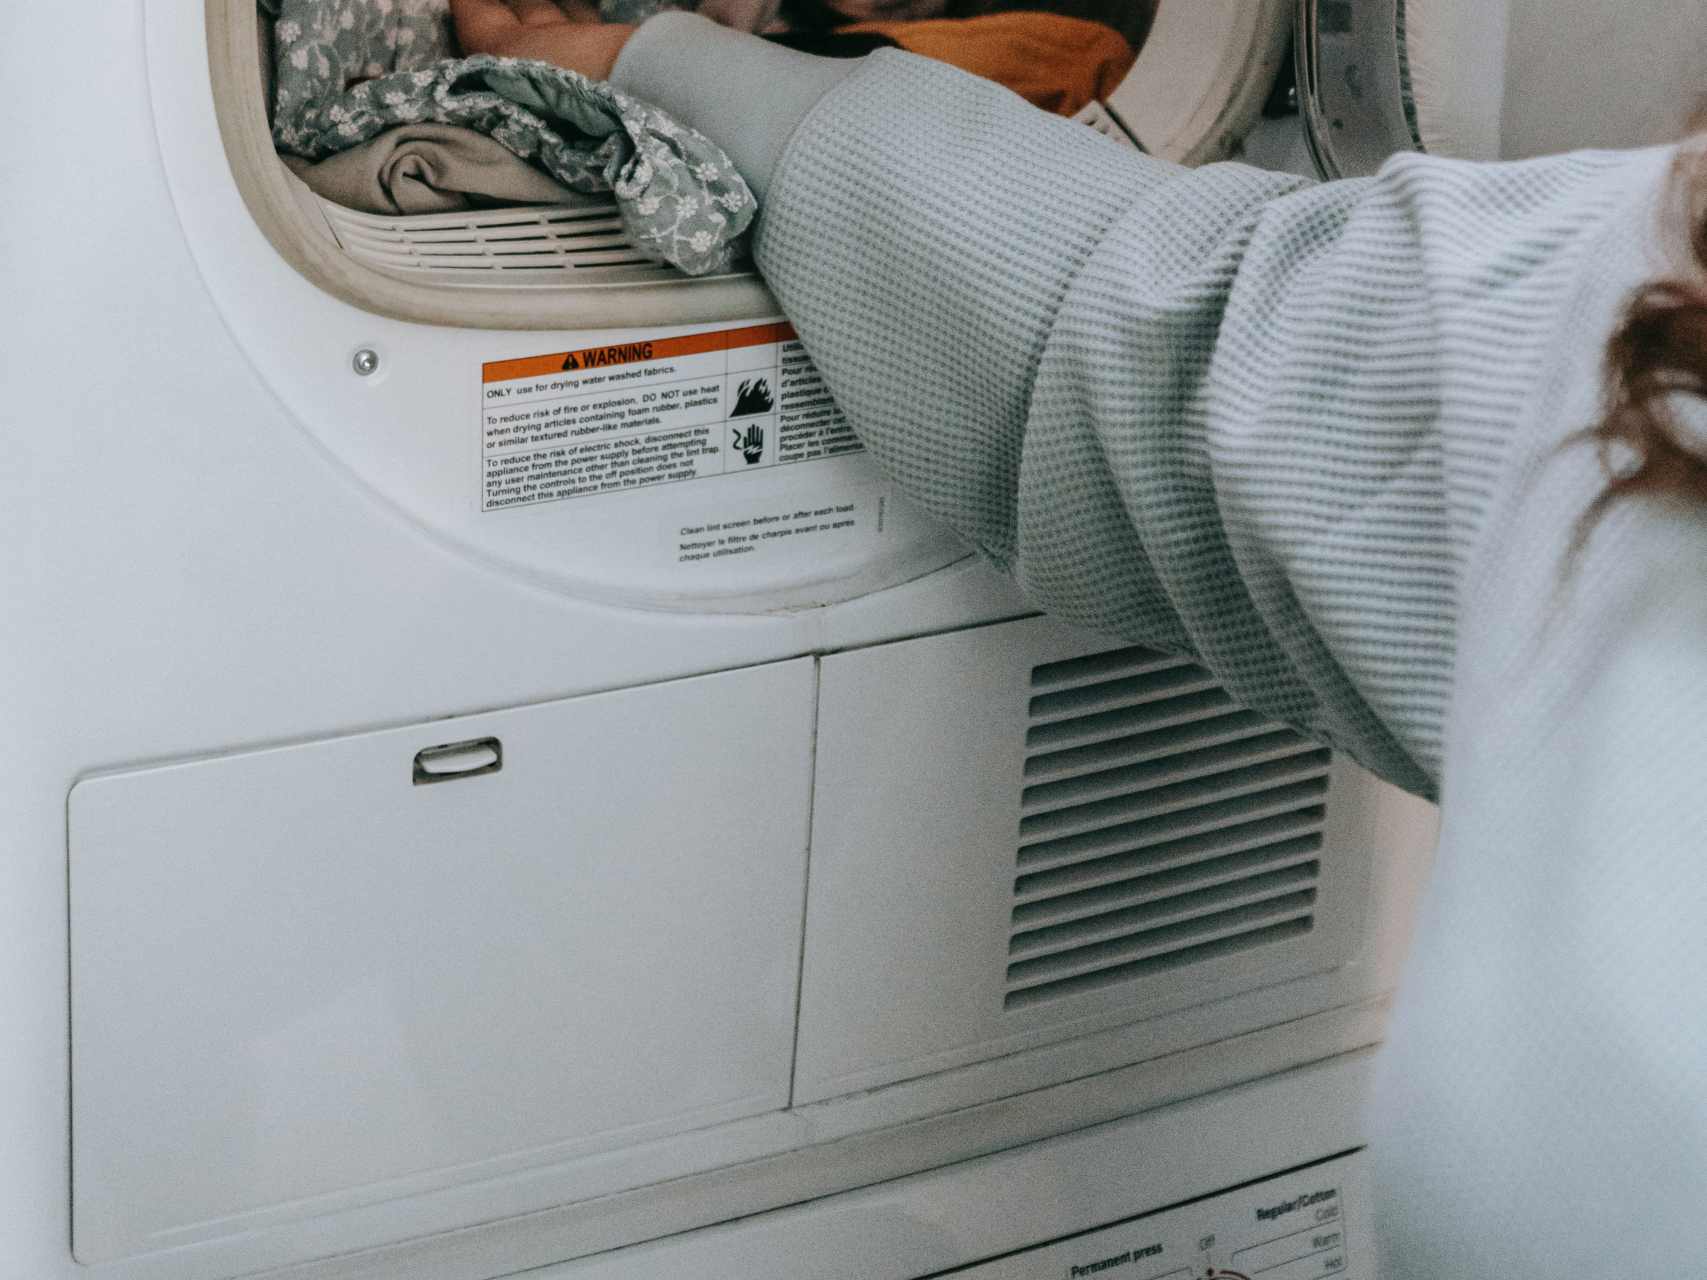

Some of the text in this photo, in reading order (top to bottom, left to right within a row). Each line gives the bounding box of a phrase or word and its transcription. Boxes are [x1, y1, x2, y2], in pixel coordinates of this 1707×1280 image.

[583, 343, 653, 367] WARNING
[487, 366, 677, 398] ONLY use for drying water washed fabrics.
[782, 368, 802, 376] Pour
[487, 417, 497, 425] To
[501, 413, 531, 423] reduce
[534, 409, 550, 419] risk
[553, 407, 561, 416] of
[564, 406, 578, 414] fire
[643, 393, 657, 403] DO
[661, 390, 680, 399] NOT
[683, 389, 698, 397] use
[701, 385, 720, 395] heat
[782, 387, 822, 400] plastique
[487, 397, 718, 437] when drying articles containing foam plastics
[781, 420, 830, 432] déconnecter
[803, 410, 831, 419] réduire
[499, 437, 529, 447] similar
[531, 430, 568, 441] textured
[571, 424, 618, 436] rubber-like
[621, 418, 662, 429] materials.
[501, 456, 531, 466] reduce
[534, 453, 548, 461] the
[550, 449, 566, 458] risk
[579, 442, 611, 453] electric
[645, 430, 692, 444] disconnect
[694, 428, 710, 437] this
[781, 443, 805, 452] Placer
[487, 439, 707, 478] appliance from the power supply before attempting
[487, 446, 721, 488] any user maintenance other than cleaning the lint trap.
[780, 450, 822, 461] coupe pas
[486, 469, 698, 508] disconnect this appliance from the power supply.
[487, 487, 521, 497] Turning
[524, 484, 537, 492] the
[540, 478, 576, 490] controls
[589, 473, 603, 481] the
[606, 471, 617, 479] off
[620, 465, 654, 478] position
[657, 461, 677, 472] does
[680, 459, 694, 467] not
[681, 526, 705, 536] Clean
[707, 524, 720, 532] lint
[723, 520, 751, 530] screen
[753, 515, 780, 526] before
[793, 511, 812, 519] after
[814, 507, 834, 517] each
[836, 504, 854, 513] load
[680, 540, 716, 551] Nettoyer
[718, 538, 725, 546] le
[728, 535, 747, 544] filtre
[749, 533, 759, 541] de
[762, 528, 793, 539] charpie
[795, 525, 818, 534] avant
[680, 552, 710, 563] chaque
[1257, 1188, 1337, 1220] Regular/Cotton
[1071, 1243, 1163, 1279] Permanent press
